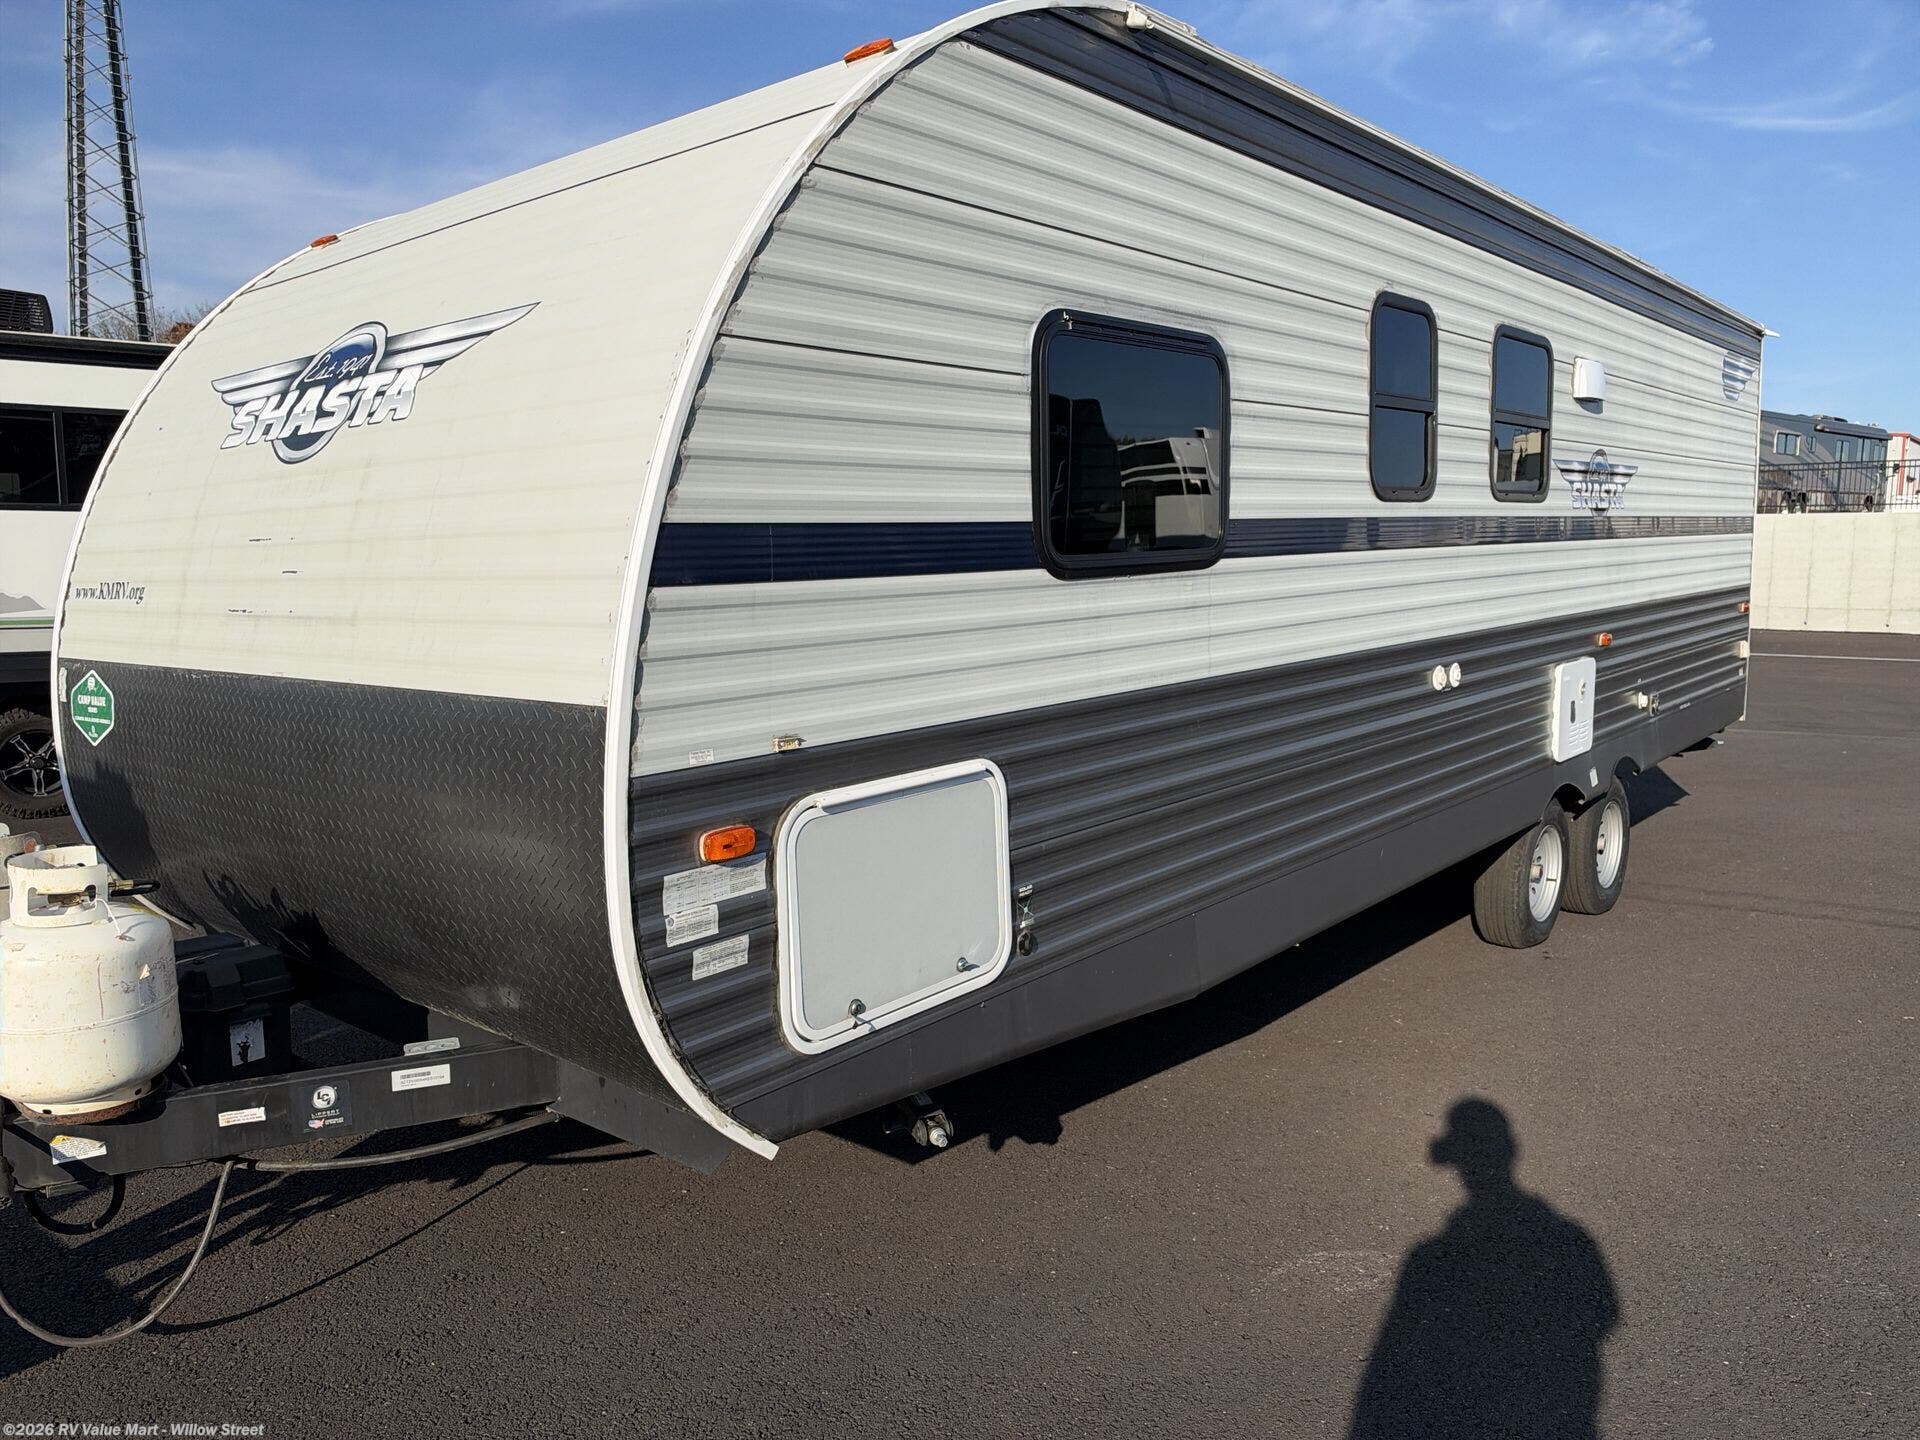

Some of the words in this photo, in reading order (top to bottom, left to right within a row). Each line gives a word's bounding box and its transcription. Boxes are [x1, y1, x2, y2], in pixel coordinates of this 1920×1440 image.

[303, 353, 334, 383] Est.
[220, 364, 425, 450] SHASTA
[1572, 482, 1625, 510] SHASTA
[75, 582, 146, 605] www.KMRV.org
